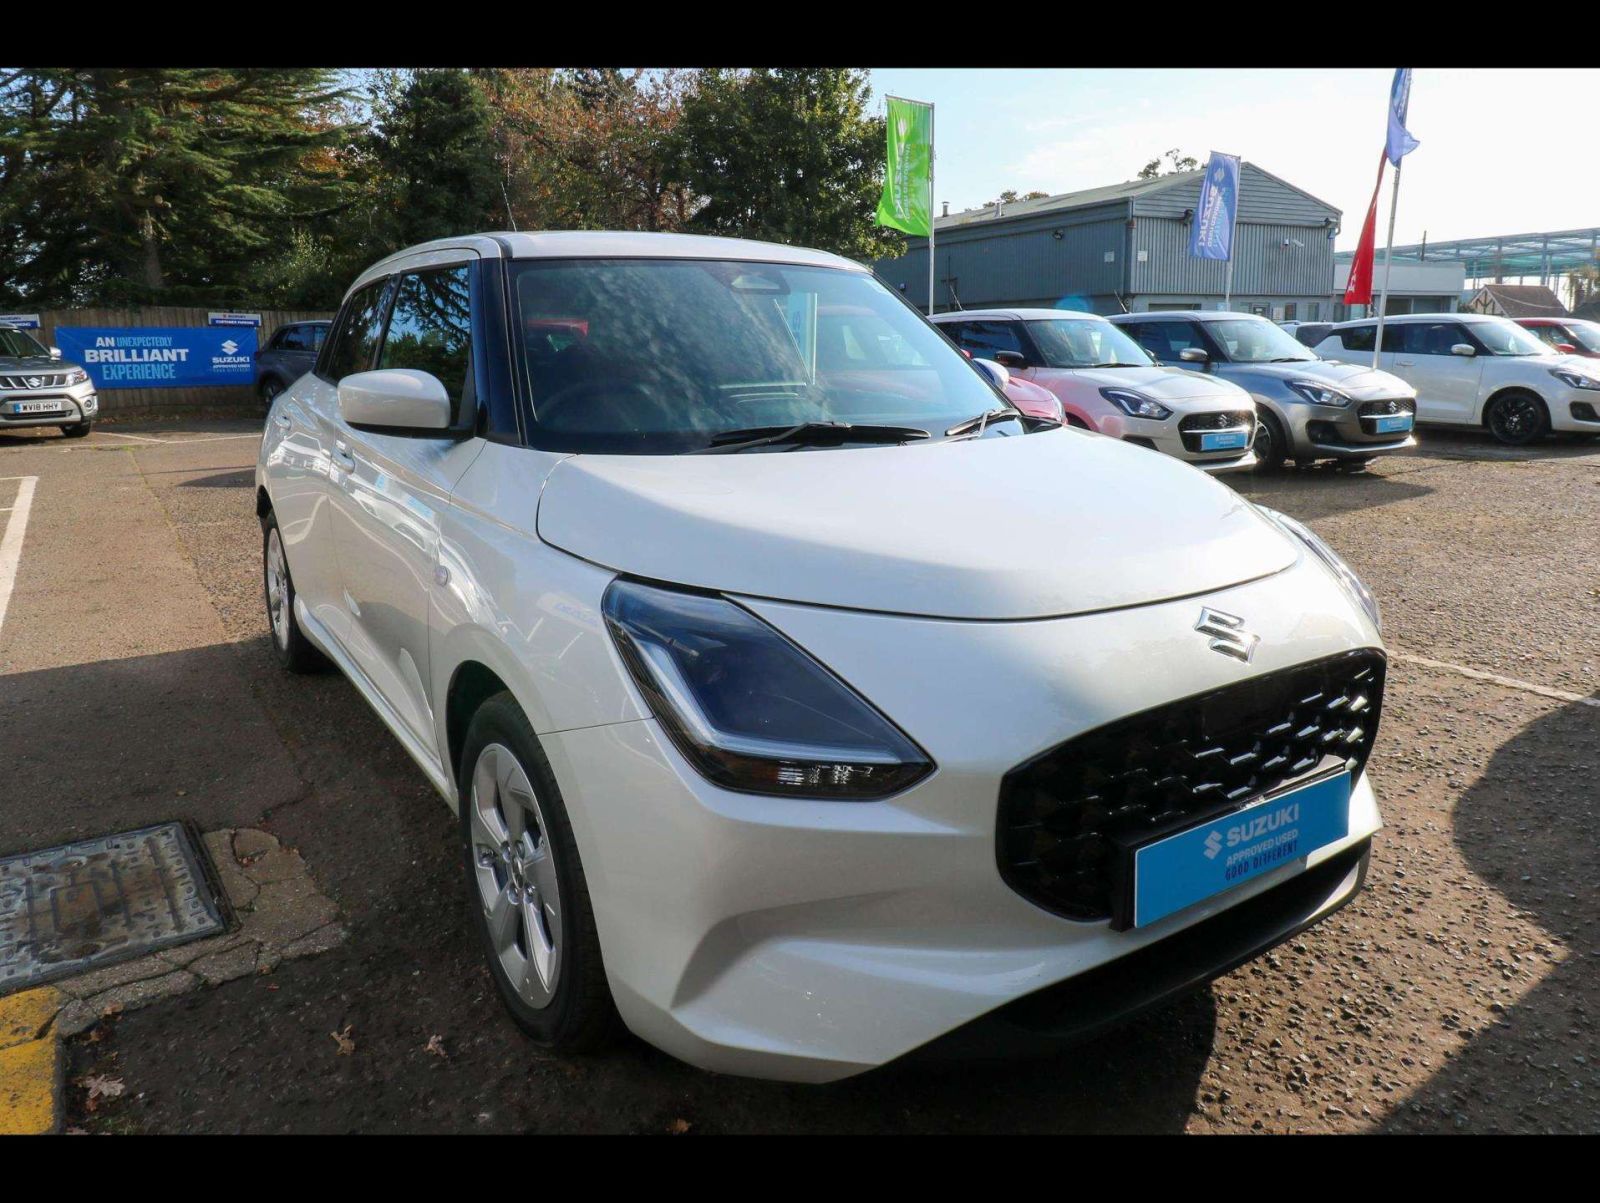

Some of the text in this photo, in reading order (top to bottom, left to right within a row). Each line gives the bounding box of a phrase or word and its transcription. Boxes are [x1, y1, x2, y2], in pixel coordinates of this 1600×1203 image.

[96, 336, 173, 348] AN UNEXPECTEDLY
[84, 348, 190, 363] BRILLIANT
[212, 356, 250, 364] SUZUKI
[102, 363, 177, 381] EXPERIENCE
[1226, 803, 1300, 848] SUZUKI
[1227, 828, 1299, 868] APPROVED USED
[1225, 839, 1298, 881] GOOD DIFFERENT
